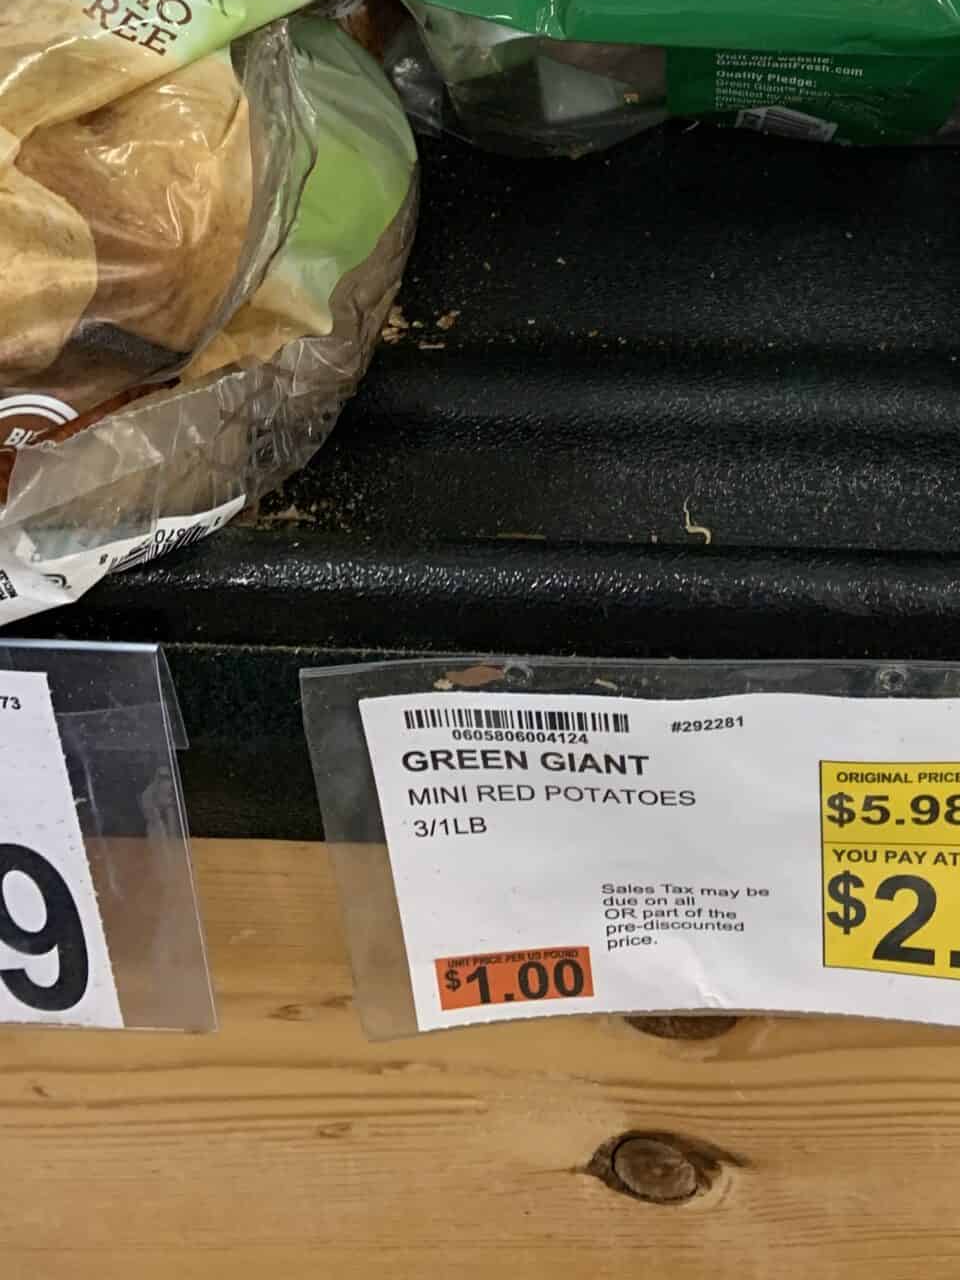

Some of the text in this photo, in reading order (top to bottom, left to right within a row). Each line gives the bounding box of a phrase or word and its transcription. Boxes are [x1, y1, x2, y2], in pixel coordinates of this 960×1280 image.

[716, 70, 763, 82] Quality
[671, 716, 744, 733] #292281
[452, 729, 589, 744] 0605806004124
[402, 749, 650, 776] GREEN GIANT
[836, 771, 913, 784] ORIGINAL
[408, 784, 696, 807] MINI RED POTATOES
[413, 816, 487, 838] 3/1LB
[832, 848, 878, 863] YOU
[885, 850, 927, 866] PAY
[602, 883, 770, 899] Sales Tax may be
[603, 895, 695, 907] due on all
[605, 908, 737, 921] OR part of the
[0, 842, 89, 1012] 9
[606, 920, 745, 936] pre-discounted
[607, 935, 658, 951] price.
[445, 960, 584, 1004] $1.00
